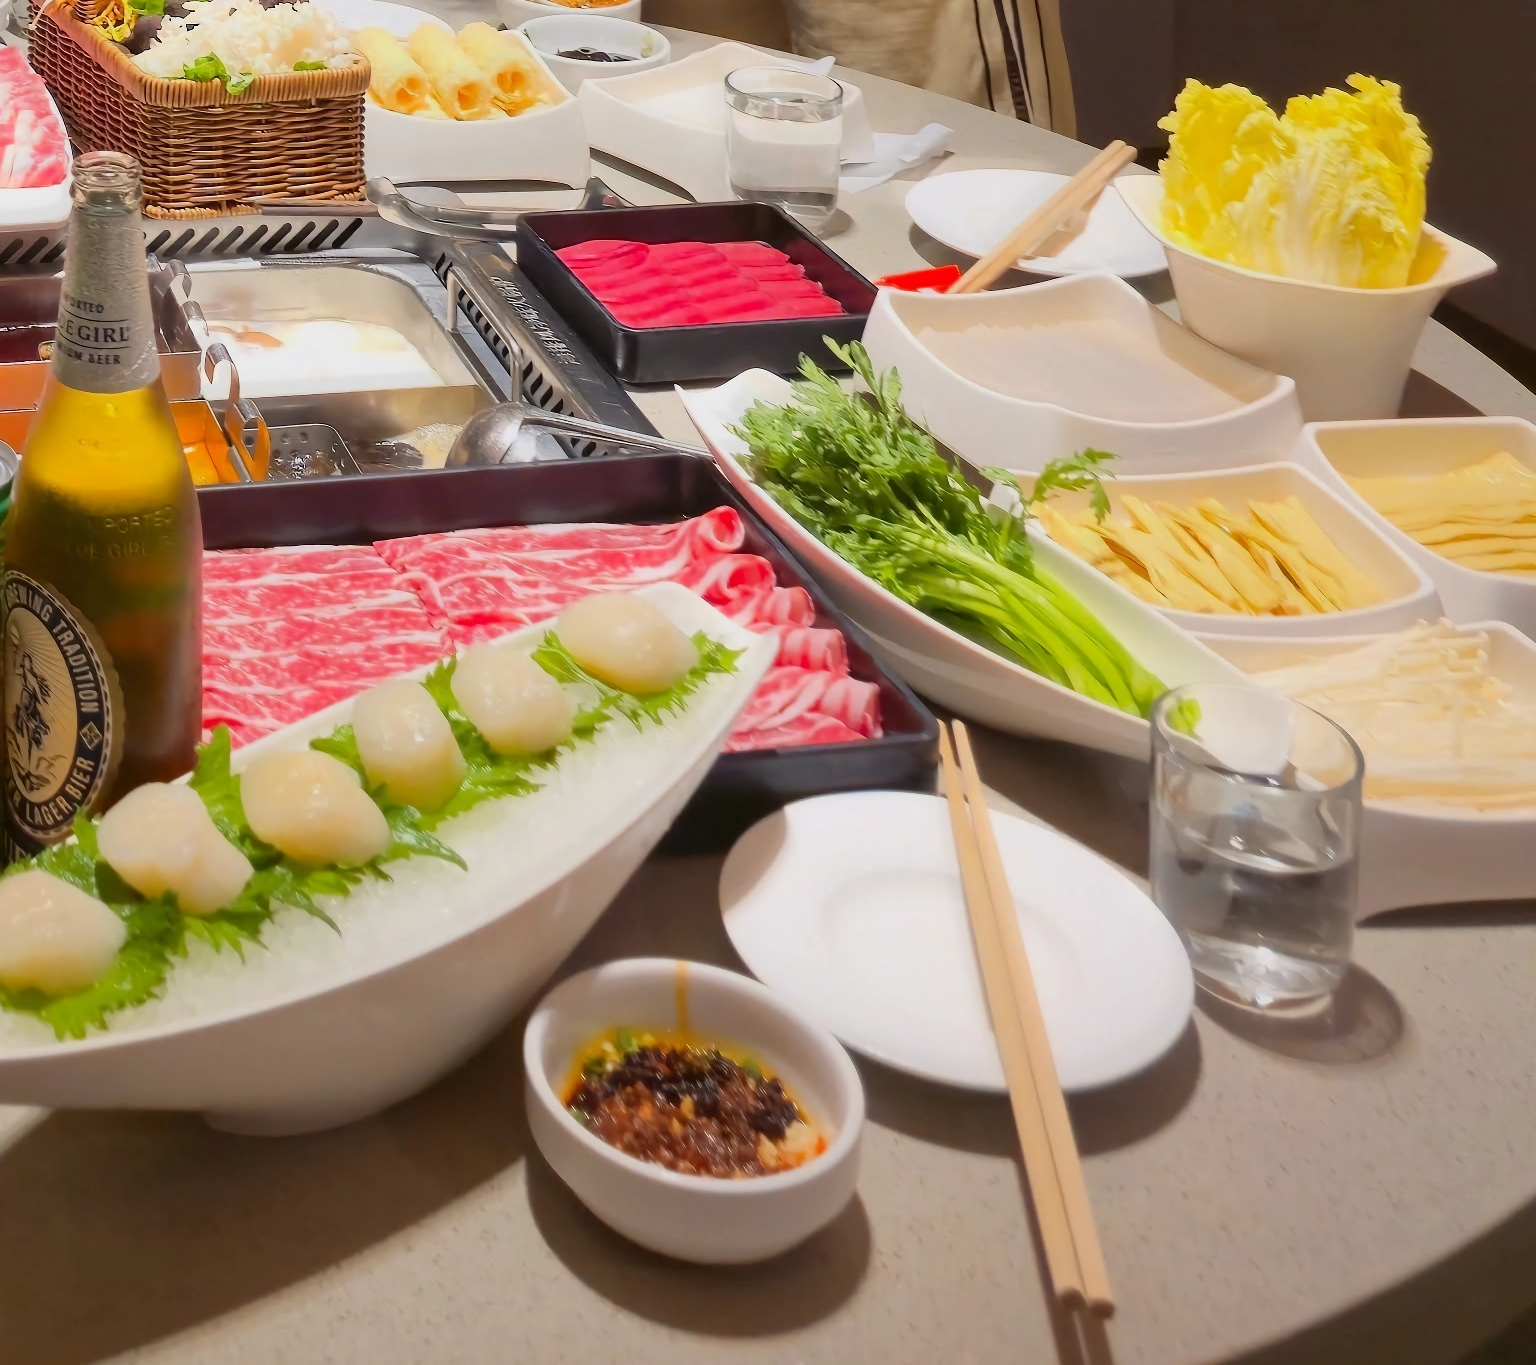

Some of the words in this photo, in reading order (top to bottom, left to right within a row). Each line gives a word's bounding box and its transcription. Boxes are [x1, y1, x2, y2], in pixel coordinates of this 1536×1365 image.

[77, 325, 130, 343] GIRL
[88, 353, 121, 365] BEER
[52, 619, 100, 714] TRADITION
[25, 795, 74, 826] LAGER
[65, 757, 96, 800] BIER
